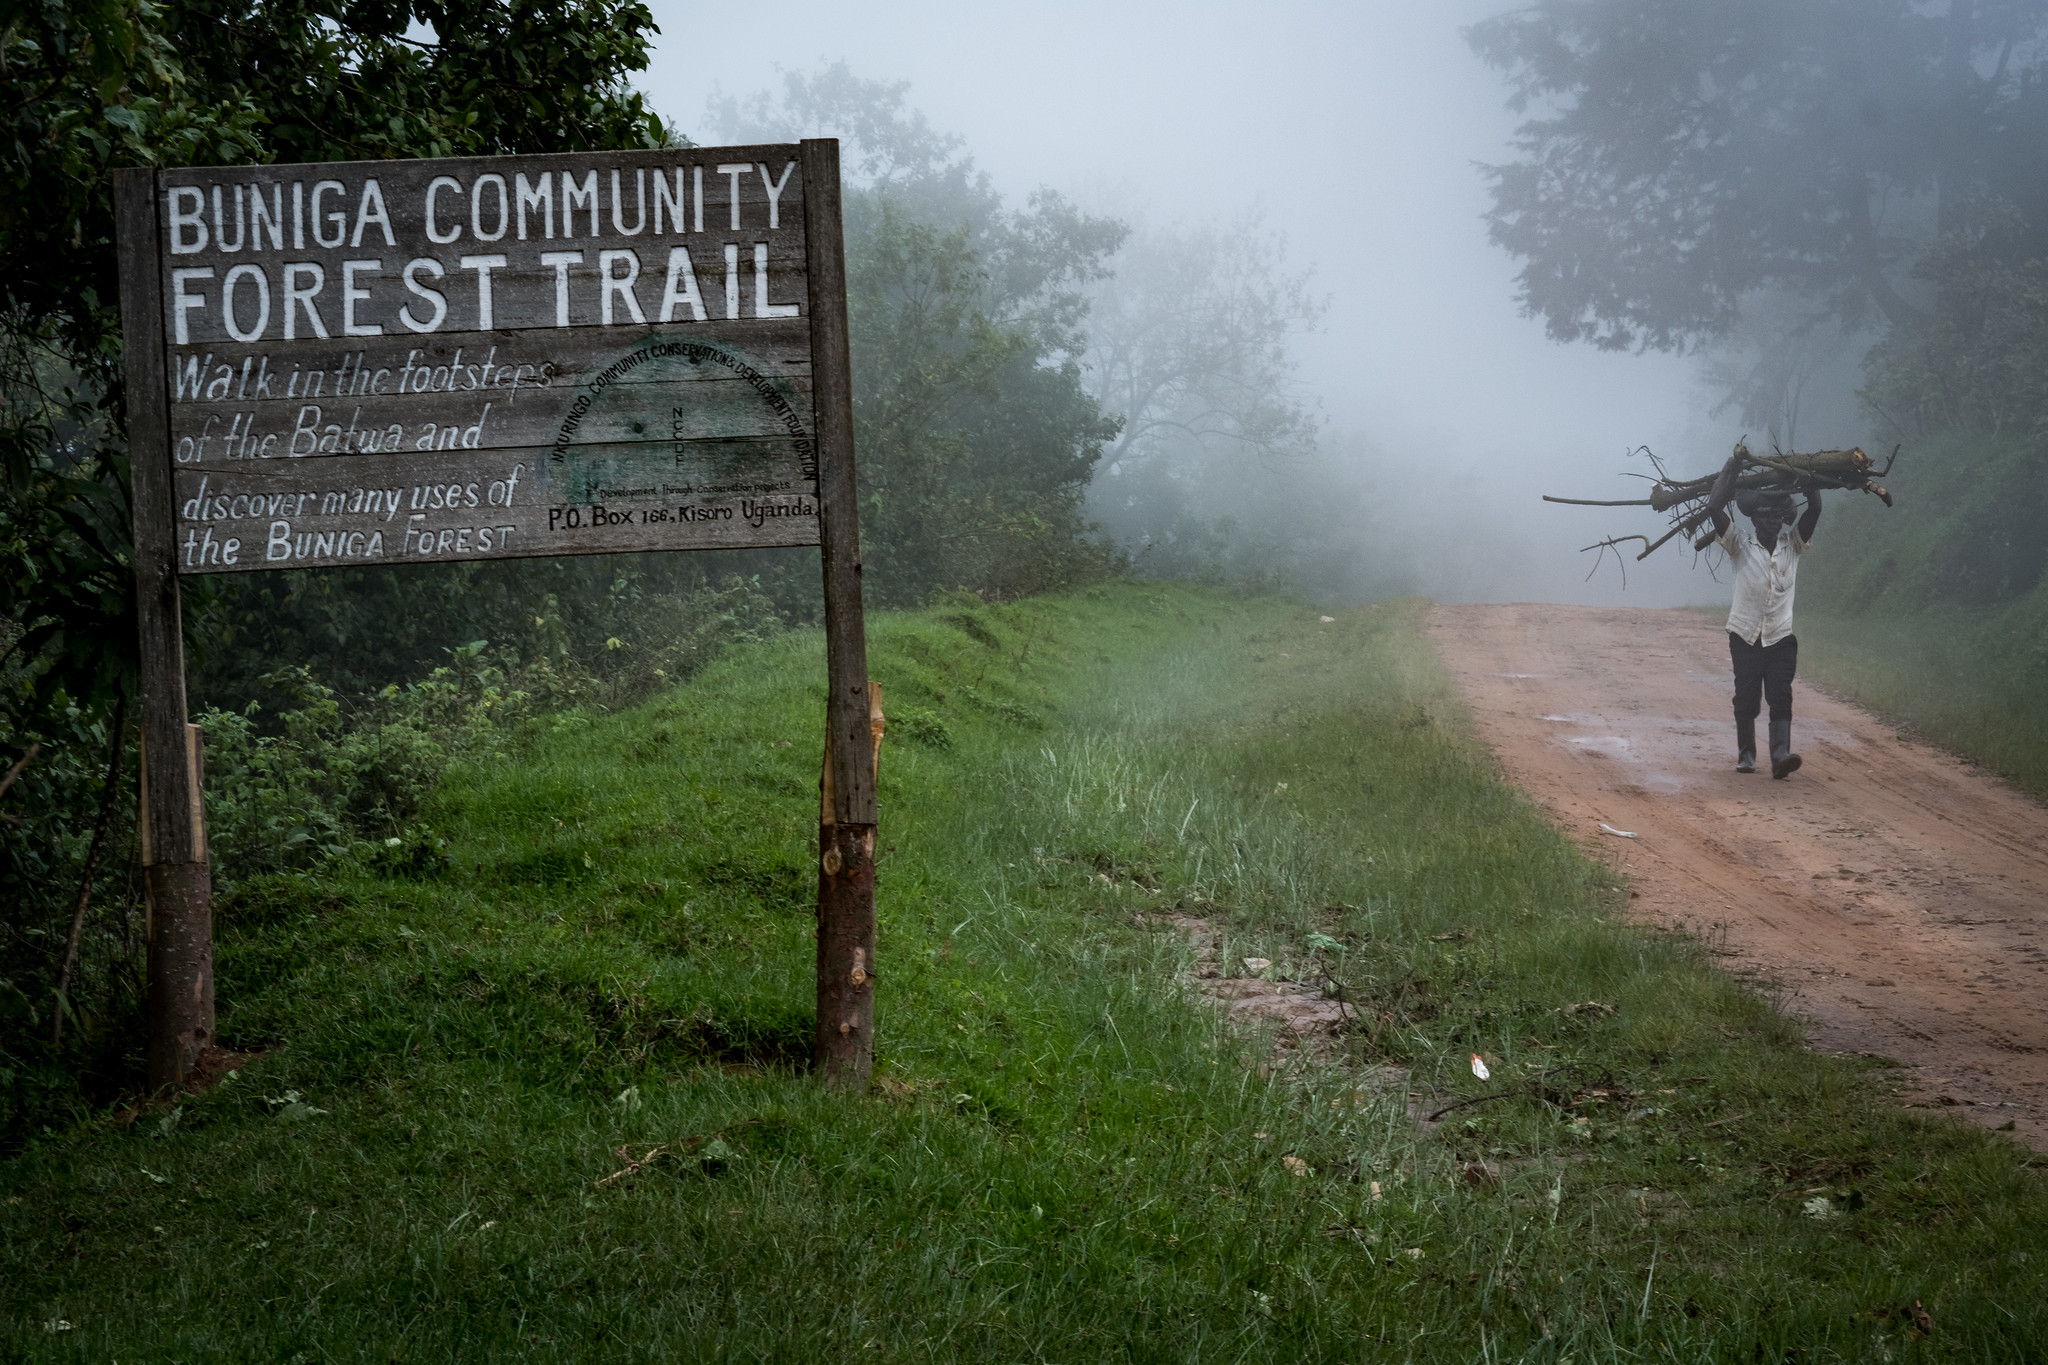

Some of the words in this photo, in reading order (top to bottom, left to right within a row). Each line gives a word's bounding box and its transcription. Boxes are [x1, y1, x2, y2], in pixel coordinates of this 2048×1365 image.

[168, 178, 397, 255] BUNIGA
[426, 161, 798, 244] COMMUNITY
[172, 253, 507, 345] FOREST
[541, 242, 800, 328] TRAIL
[174, 352, 274, 401] Walk
[287, 362, 324, 399] in
[333, 350, 391, 397] the
[399, 345, 554, 401] footsteps
[552, 395, 591, 463] NKURINGO
[589, 347, 651, 395] COMMUNITY
[650, 342, 730, 366] CONSERVATION
[734, 362, 793, 421] DEVELOPMENT
[175, 414, 221, 464] of
[224, 411, 278, 460] the
[289, 404, 403, 458] Batwa
[415, 403, 492, 451] and
[183, 474, 317, 521] discover
[320, 486, 403, 522] many
[412, 480, 480, 510] uses
[487, 463, 525, 507] of
[592, 506, 634, 528] Box
[678, 504, 733, 523] Kisoro
[184, 527, 240, 566] the
[266, 519, 385, 561] BUNIGA
[403, 513, 515, 556] FOREST
